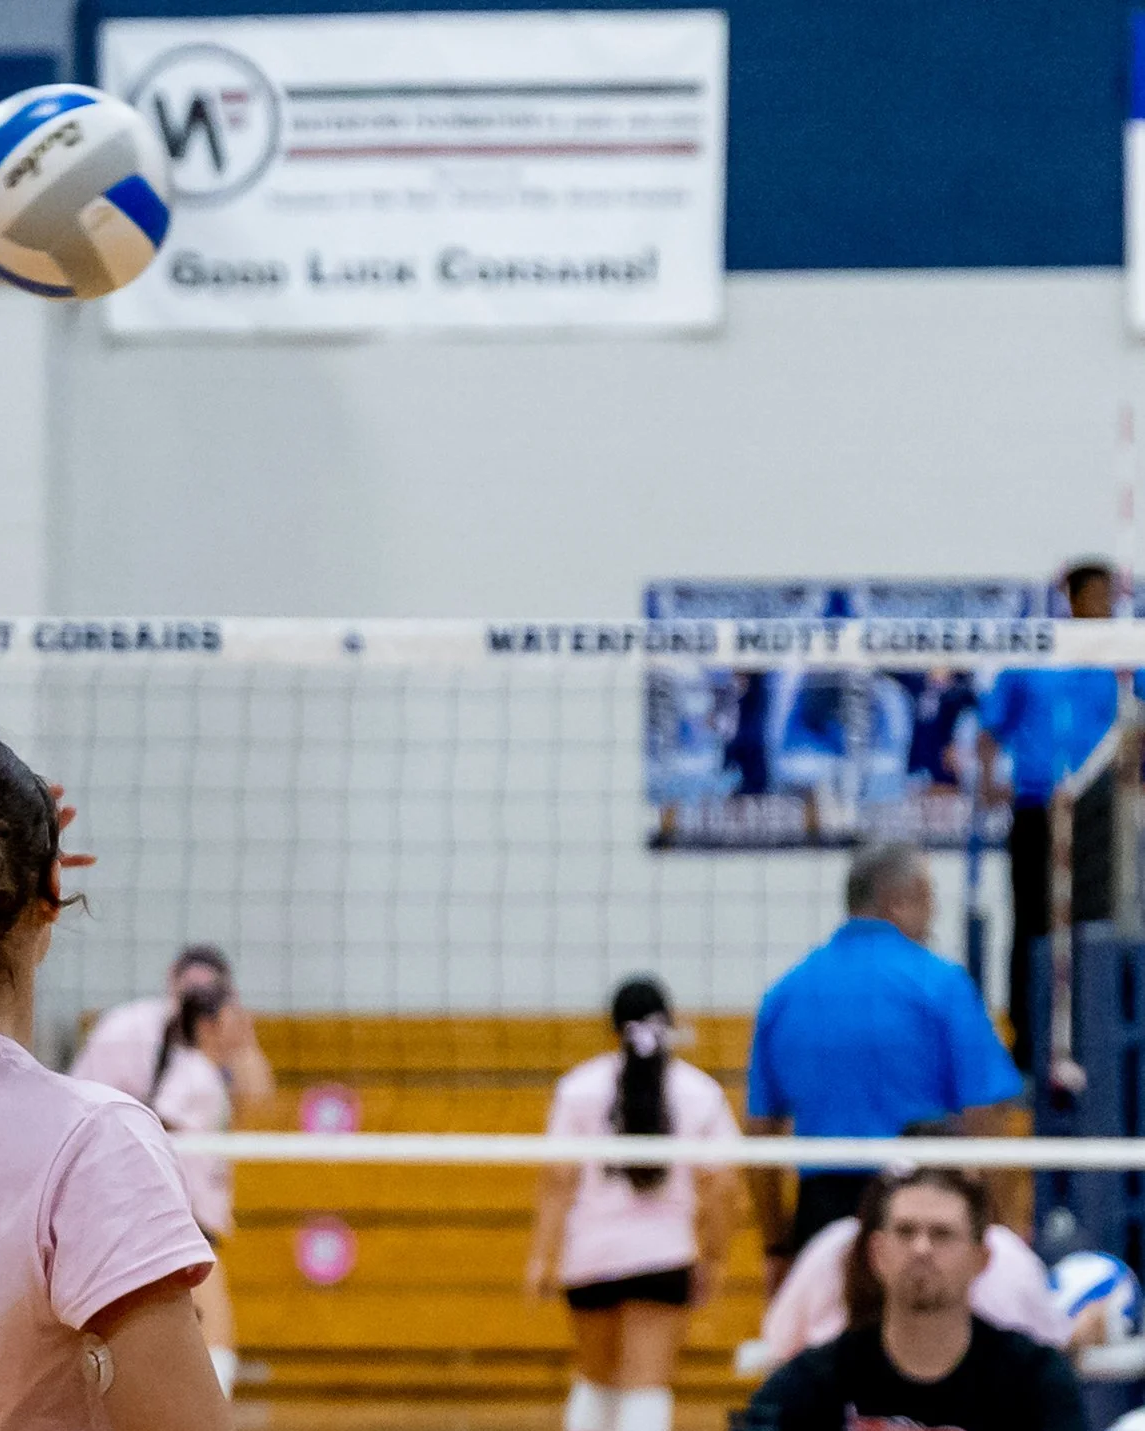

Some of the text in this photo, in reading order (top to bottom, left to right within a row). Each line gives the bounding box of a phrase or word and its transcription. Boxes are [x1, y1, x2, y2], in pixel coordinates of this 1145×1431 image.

[31, 620, 223, 652] CORSAIRS
[485, 624, 718, 654] WATERFORD
[734, 623, 843, 653] MOTT
